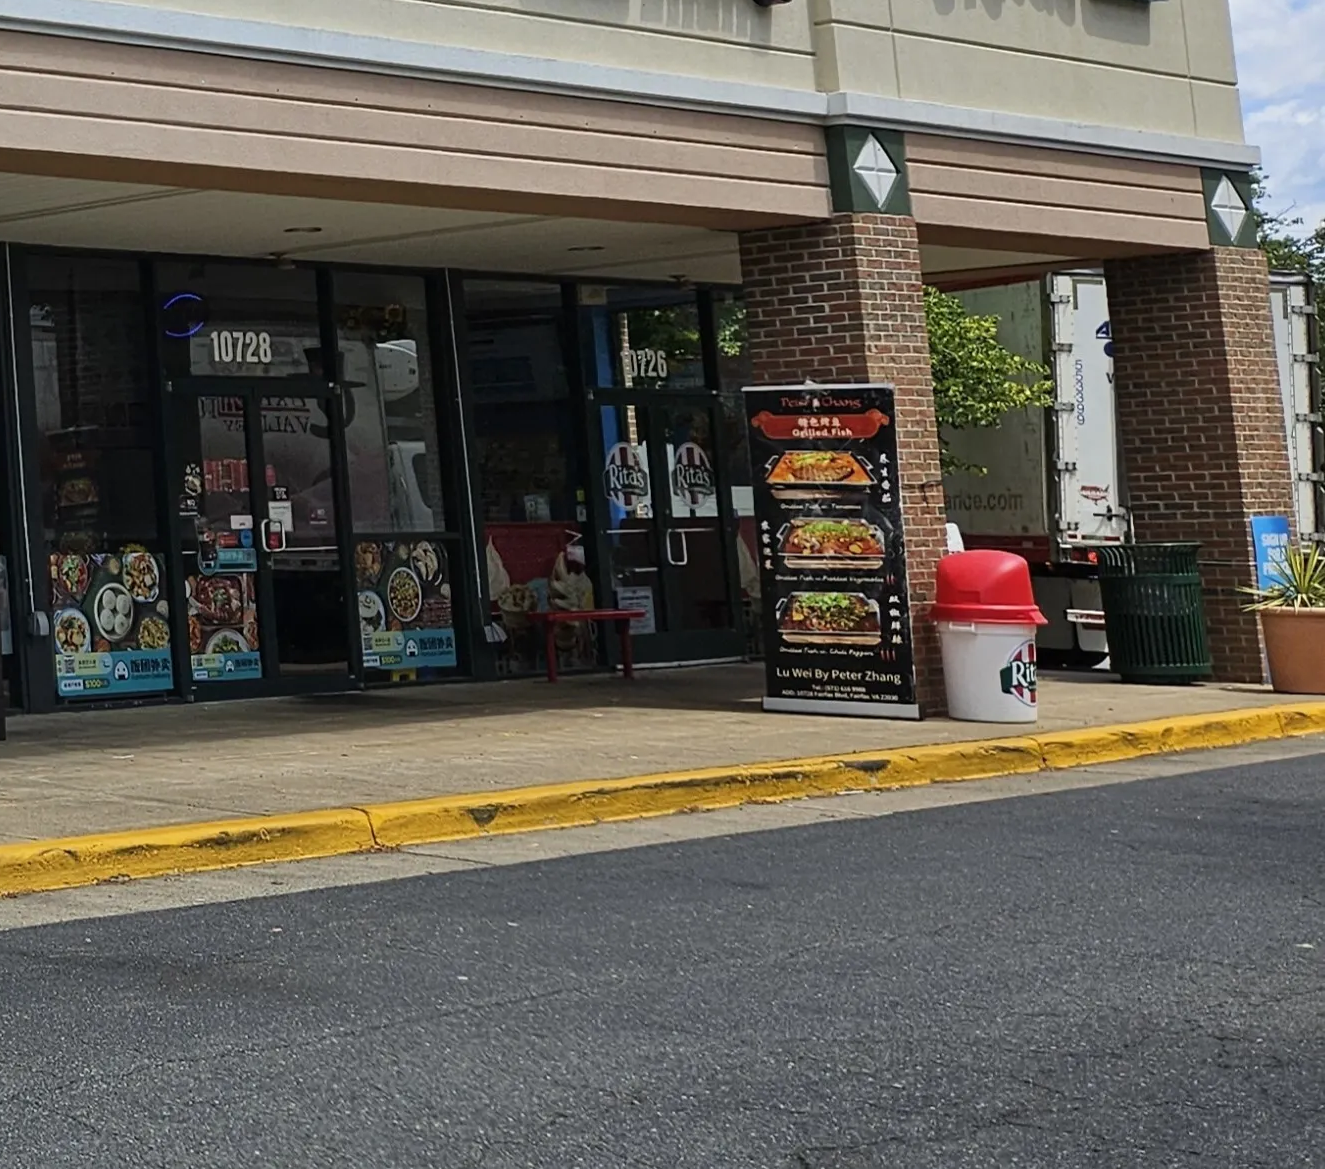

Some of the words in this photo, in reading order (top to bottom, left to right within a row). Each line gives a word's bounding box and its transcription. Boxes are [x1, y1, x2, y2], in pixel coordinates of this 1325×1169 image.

[210, 331, 272, 363] 10728
[1073, 359, 1085, 426] 553399
[792, 428, 828, 438] Grilled
[831, 428, 853, 437] Fish
[609, 463, 645, 489] Rita's
[676, 462, 711, 488] Rita's
[776, 667, 790, 677] Lu
[791, 668, 812, 678] Wei
[815, 669, 829, 681] By
[831, 669, 862, 680] Peter
[865, 671, 901, 685] Zhang
[1012, 661, 1037, 686] Rit
